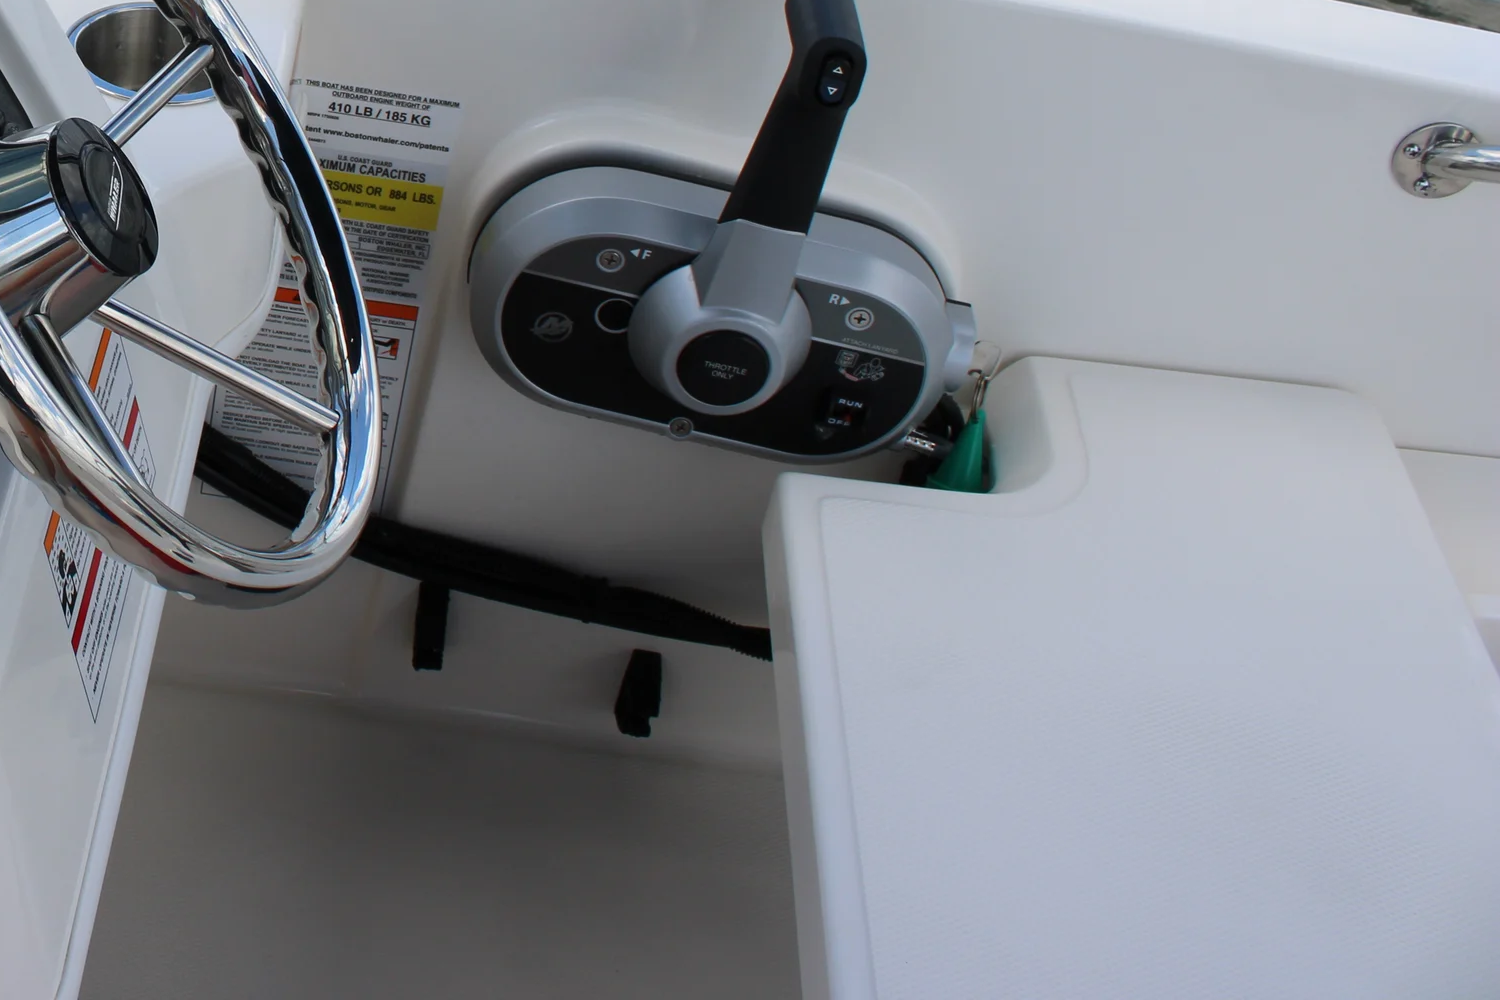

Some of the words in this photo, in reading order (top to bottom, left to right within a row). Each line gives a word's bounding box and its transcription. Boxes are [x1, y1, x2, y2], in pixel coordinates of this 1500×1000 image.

[306, 79, 320, 87] THIS
[322, 81, 339, 89] BOAT
[355, 86, 373, 94] BEEN
[374, 89, 407, 100] DESIGNED
[429, 98, 460, 108] MAXIMUM
[332, 90, 368, 102] OUTBOARD
[370, 97, 394, 106] ENGINE
[395, 100, 420, 109] WEIGHT
[328, 102, 352, 114] 410
[355, 105, 373, 117] LB
[376, 109, 382, 118] /
[385, 110, 408, 122] 185
[411, 114, 431, 126] KG
[323, 128, 449, 152] www.bostonwhaler.com/patents
[350, 156, 370, 164] COAST
[371, 159, 393, 168] GUARD
[359, 164, 426, 183] CAPACITIES
[366, 186, 383, 197] OR
[389, 189, 407, 201] 884
[412, 192, 436, 205] LBS.
[358, 236, 385, 245] BOSTON
[641, 249, 652, 260] F
[828, 293, 839, 305] R
[704, 360, 748, 376] THROTTLE
[711, 369, 734, 380] ONLY
[838, 398, 863, 408] RUN
[827, 417, 851, 426] OFF
